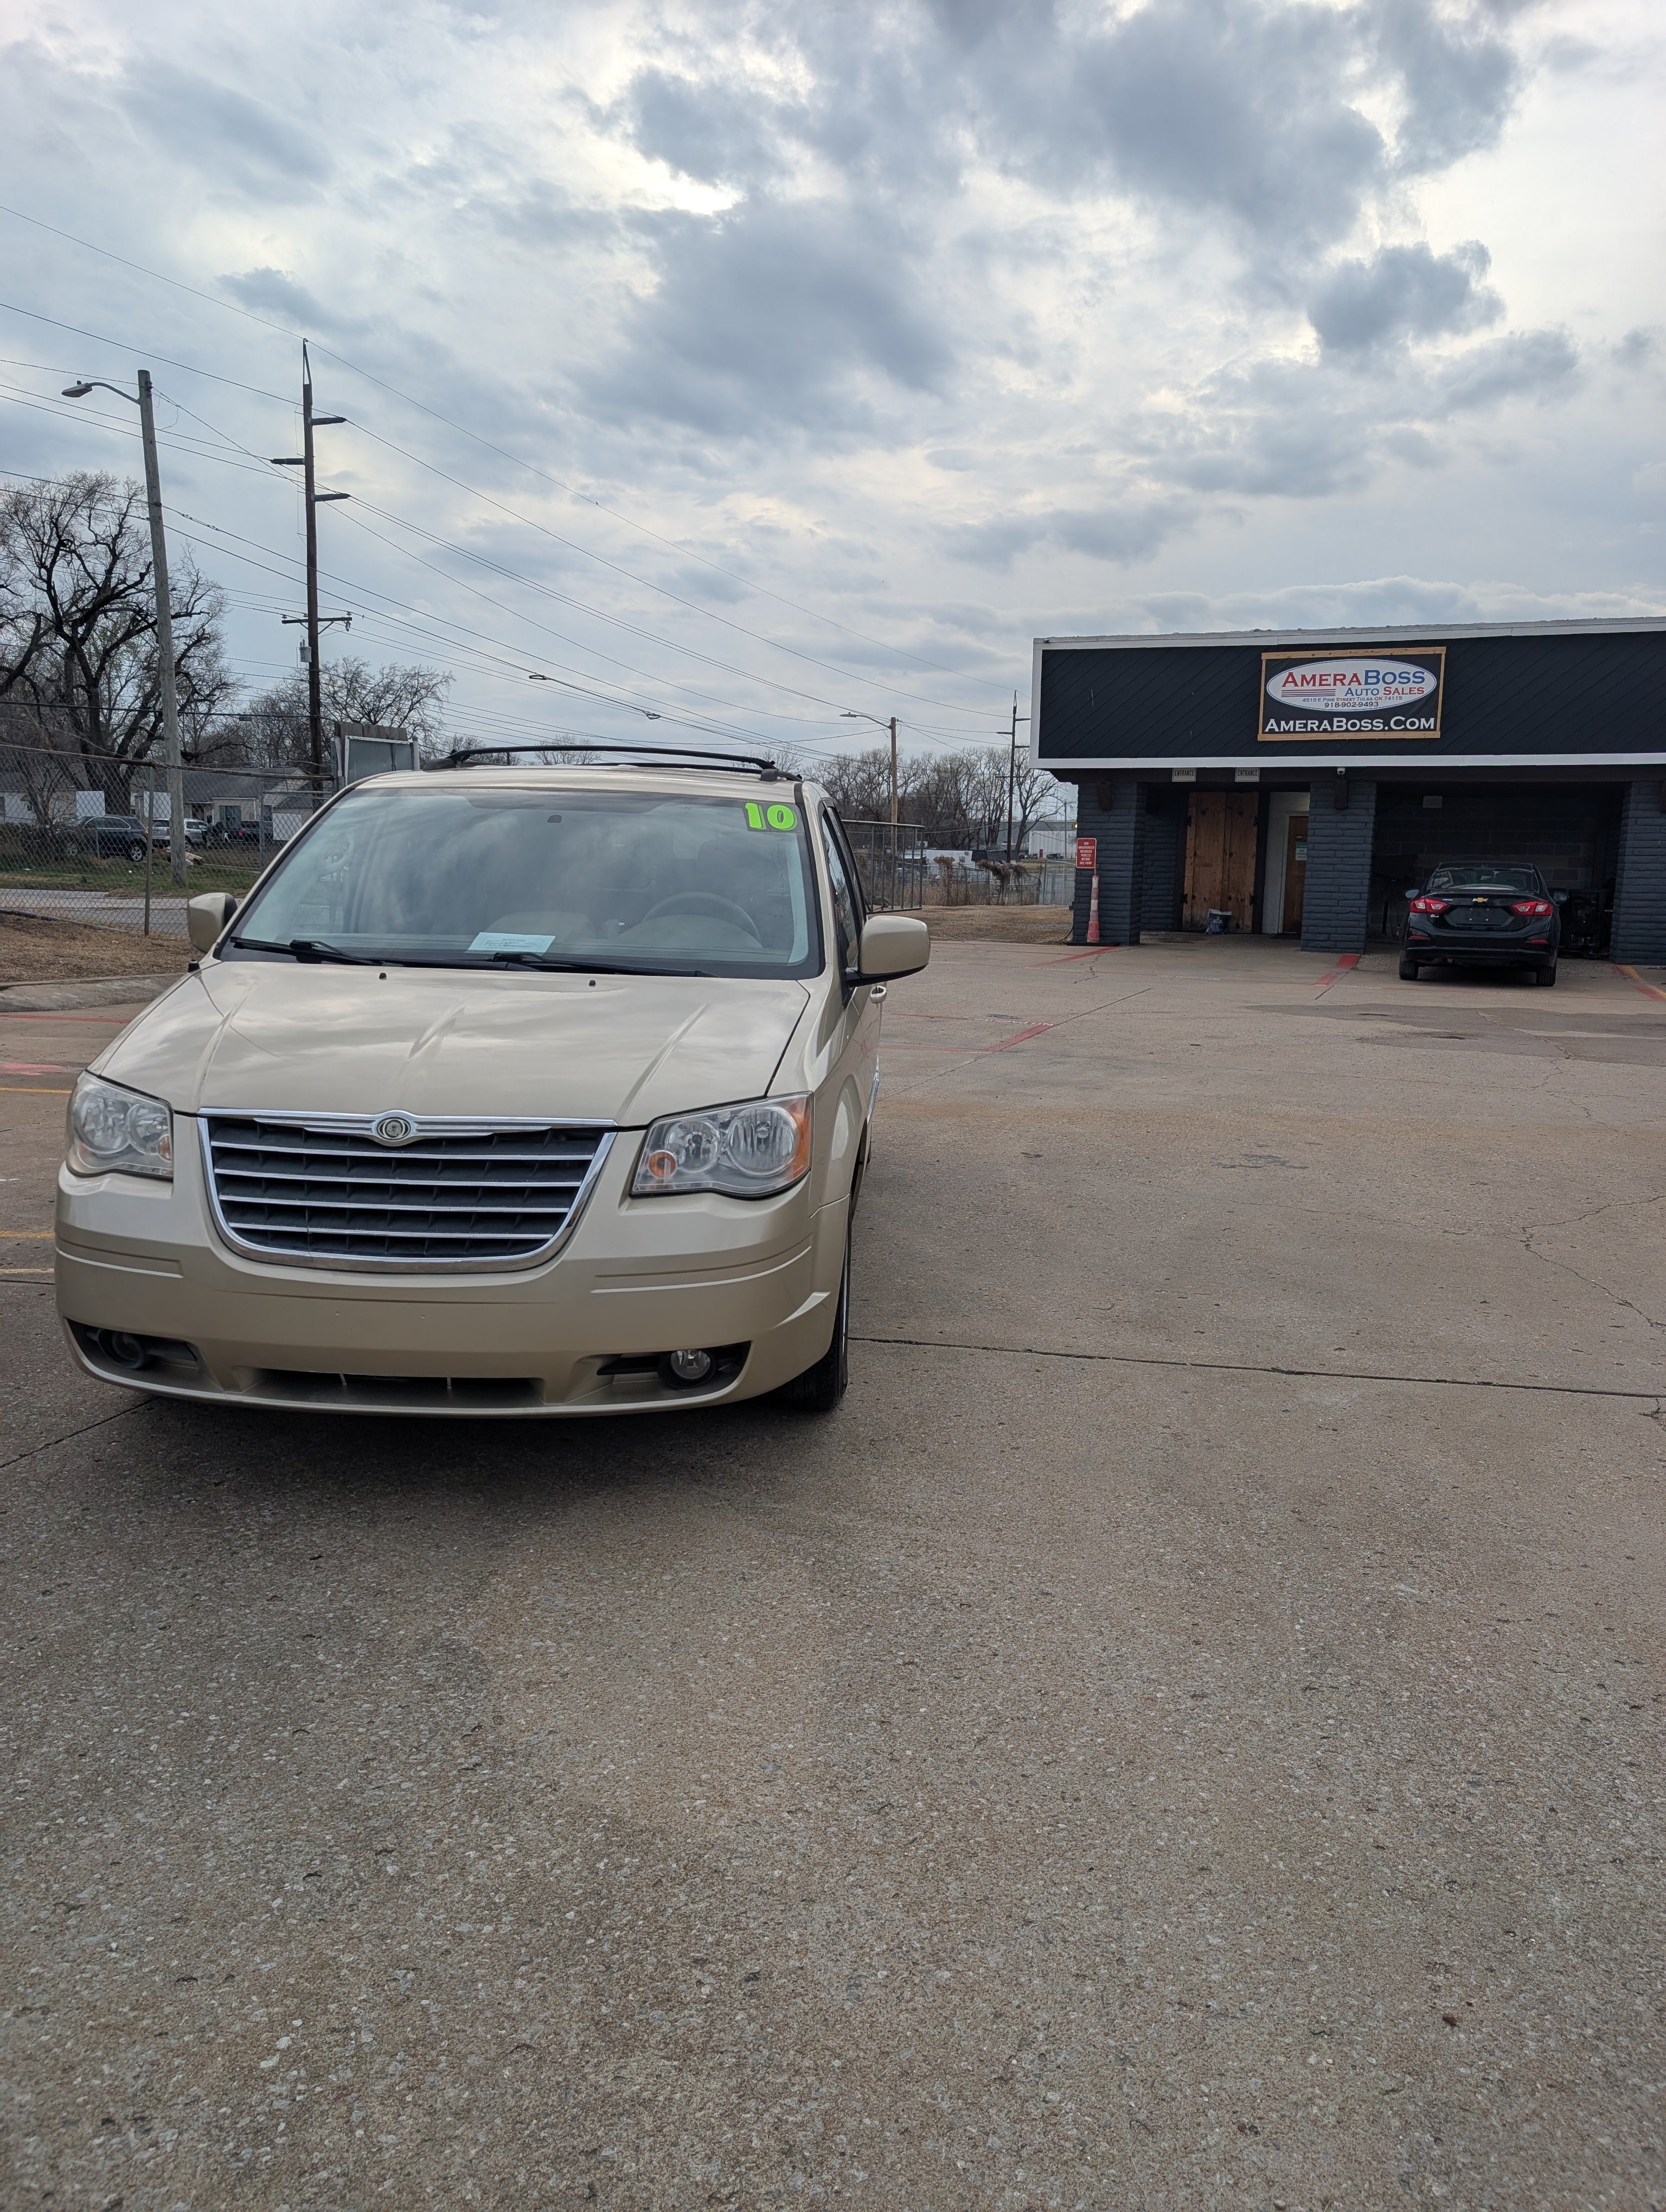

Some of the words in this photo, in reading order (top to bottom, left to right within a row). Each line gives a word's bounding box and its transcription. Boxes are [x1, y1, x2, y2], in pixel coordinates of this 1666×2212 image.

[1281, 670, 1426, 687] AMERABOSS
[1344, 687, 1380, 697] AUTO
[1383, 686, 1425, 696] SALES
[1264, 716, 1436, 732] AMERABOSS.COM
[745, 802, 798, 831] 10
